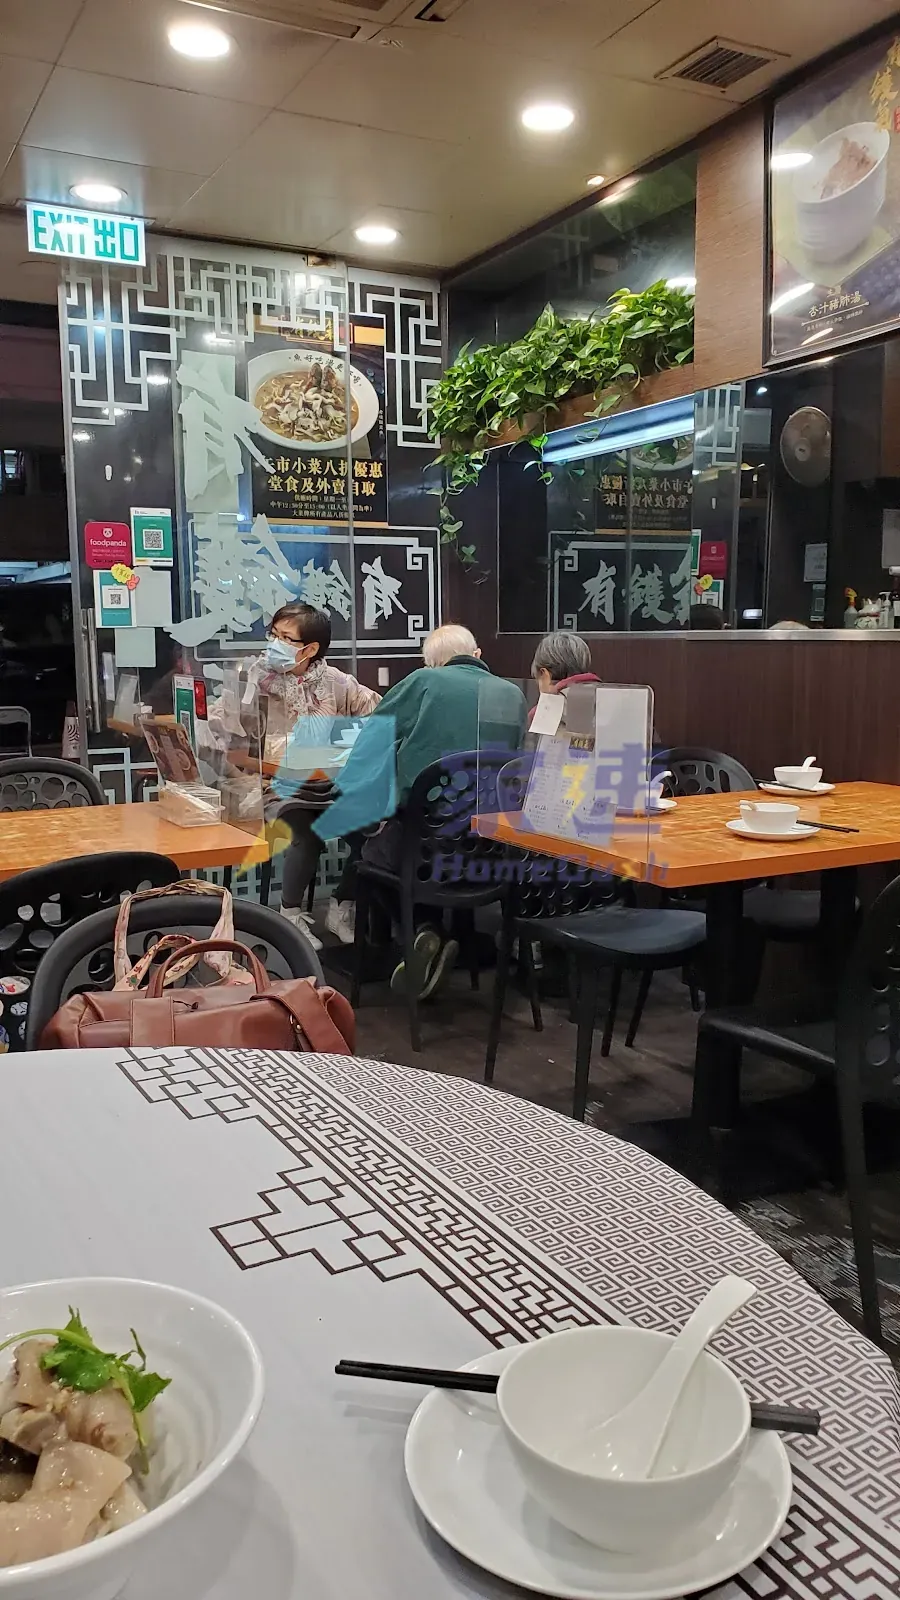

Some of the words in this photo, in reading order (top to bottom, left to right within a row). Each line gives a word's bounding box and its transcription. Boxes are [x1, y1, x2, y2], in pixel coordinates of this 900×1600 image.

[32, 210, 89, 255] EXIT
[93, 218, 140, 262] 出口
[808, 290, 863, 318] 杏汁豬肺湯
[288, 352, 363, 386] 魚好吃湯更喝
[267, 475, 377, 497] 堂食及外賣自取
[89, 538, 127, 547] foodpanda
